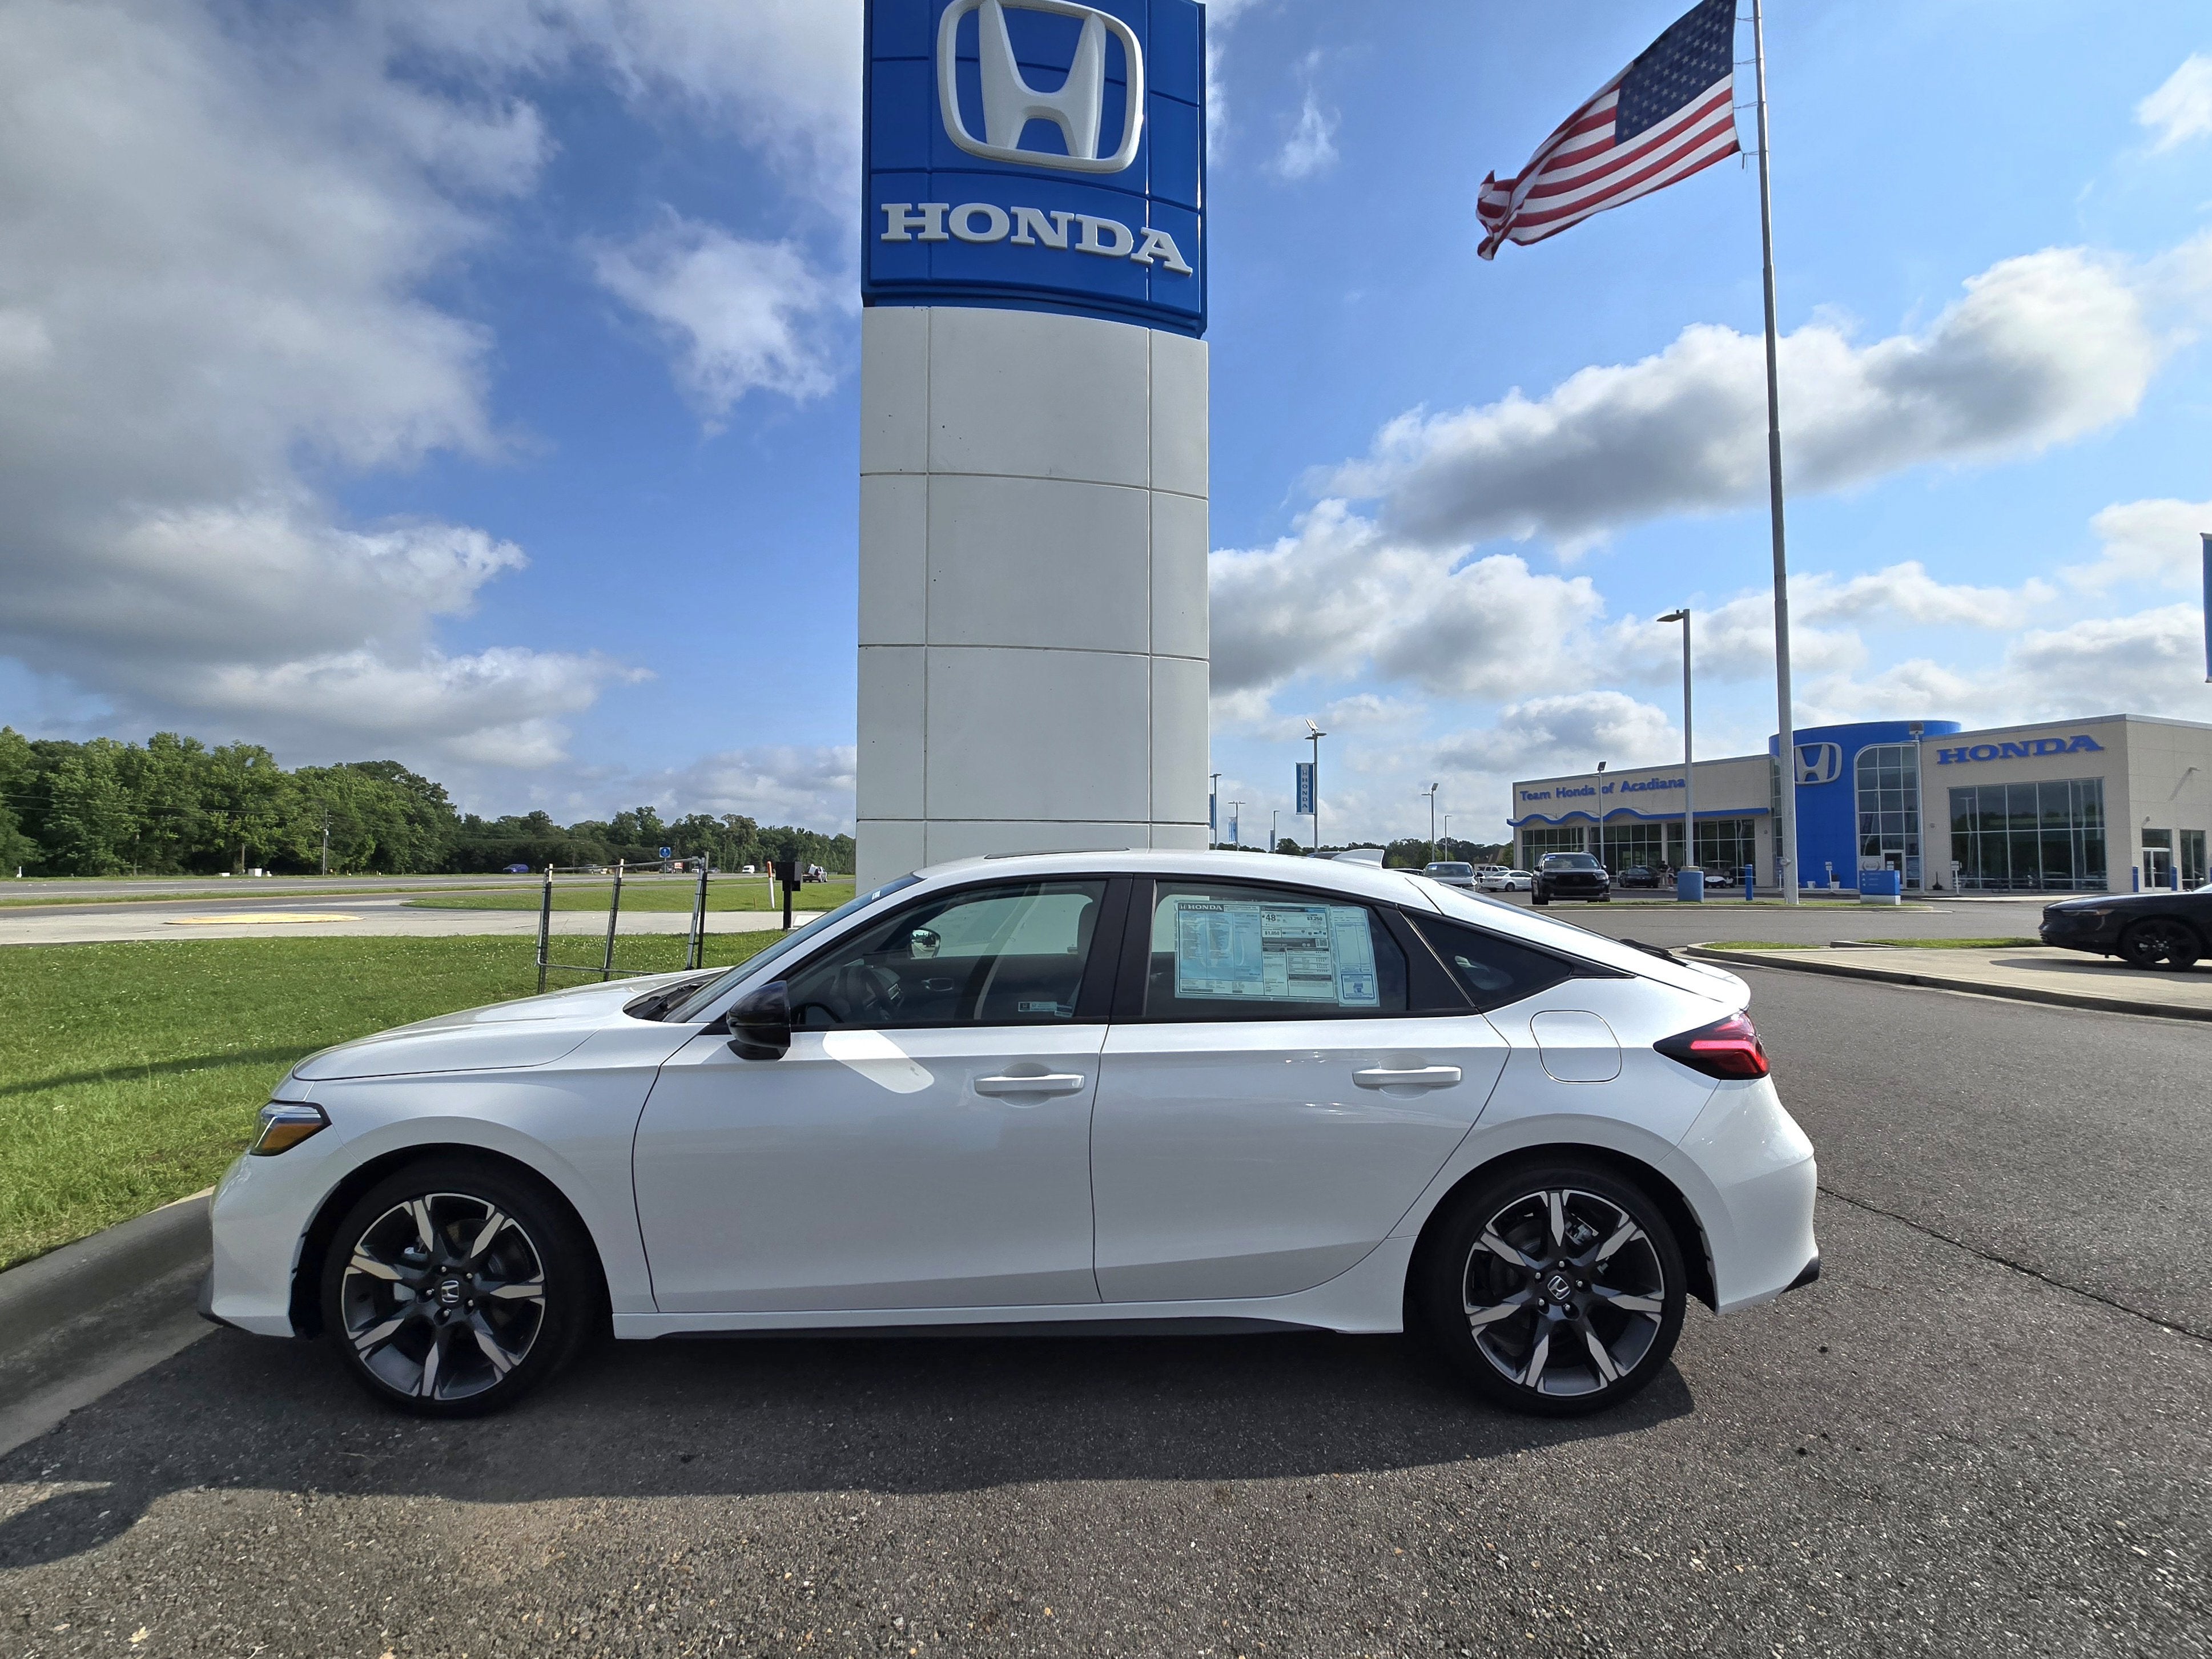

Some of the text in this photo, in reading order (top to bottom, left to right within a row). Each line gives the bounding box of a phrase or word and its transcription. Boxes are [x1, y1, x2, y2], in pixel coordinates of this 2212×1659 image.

[880, 203, 1193, 276] HONDA
[1936, 735, 2105, 765] HONDA
[1519, 778, 1686, 801] Team Honda of Acadiana
